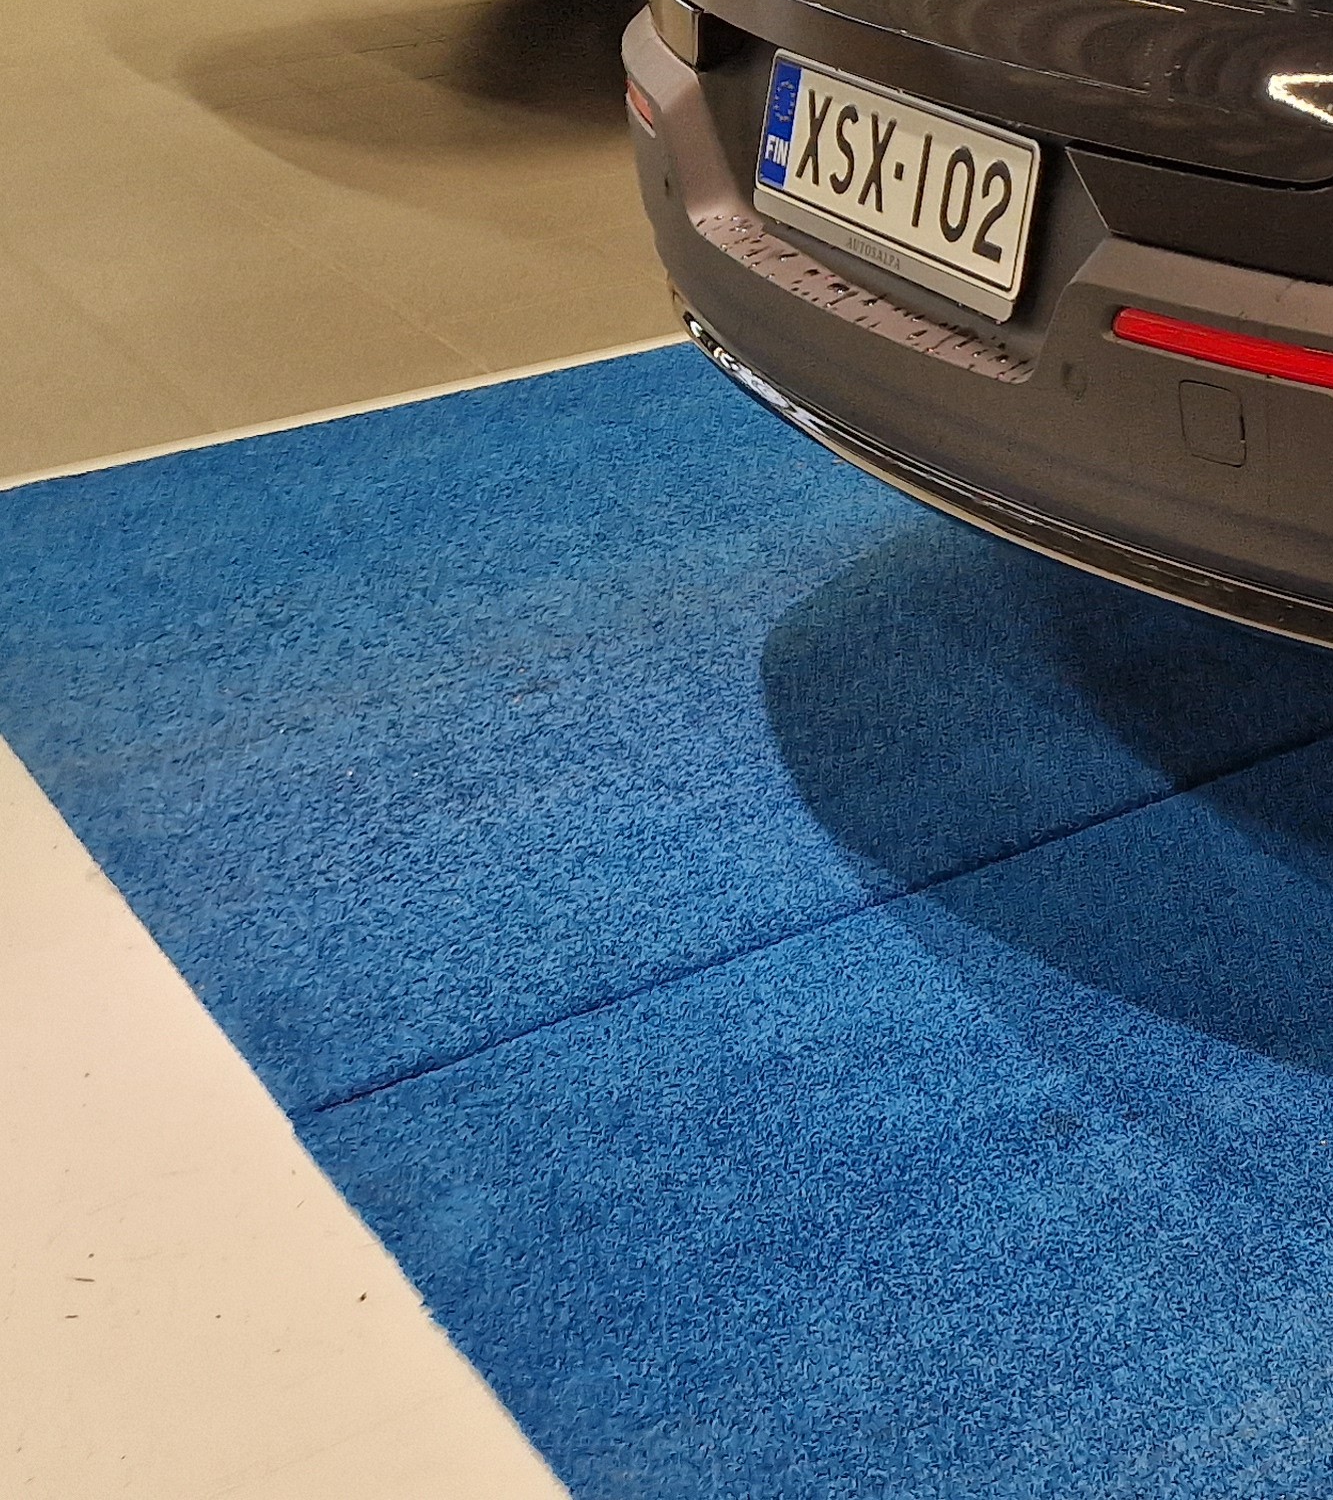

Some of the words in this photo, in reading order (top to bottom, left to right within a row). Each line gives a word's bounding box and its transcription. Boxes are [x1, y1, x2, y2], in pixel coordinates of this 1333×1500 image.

[765, 133, 789, 168] FIN
[795, 88, 1013, 263] XSX-102
[845, 236, 901, 271] AUTOSALPA
